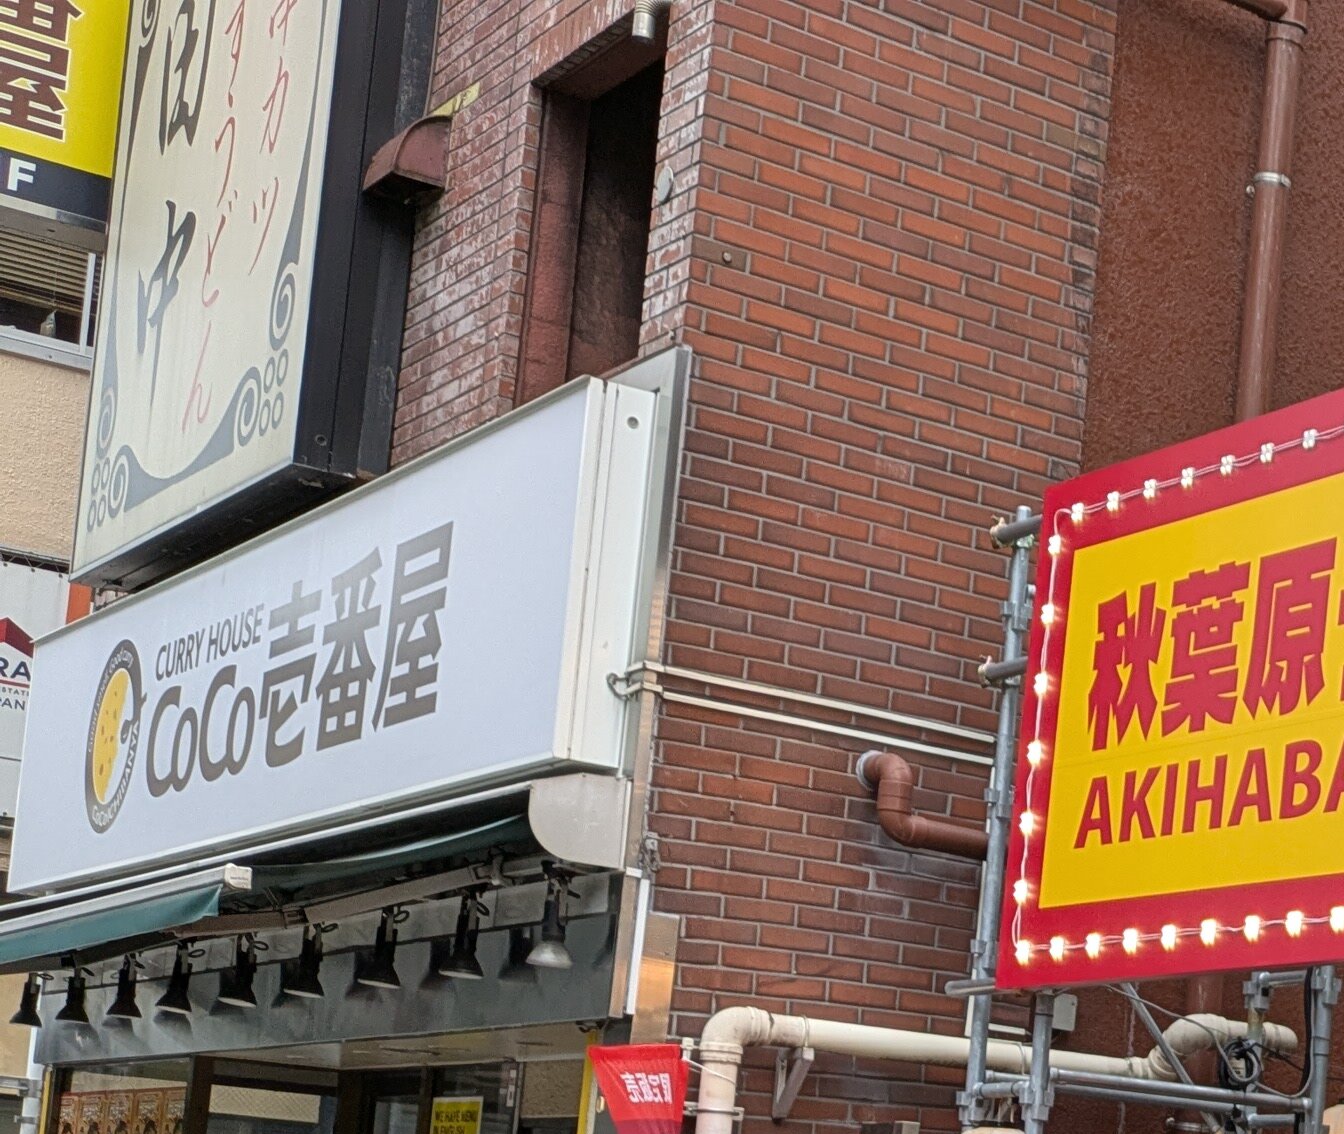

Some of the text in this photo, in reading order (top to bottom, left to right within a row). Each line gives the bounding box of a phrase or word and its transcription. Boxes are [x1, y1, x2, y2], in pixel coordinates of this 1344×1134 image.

[146, 521, 454, 798] CoCo壱番屋
[155, 603, 264, 681] CURRY HOUSE
